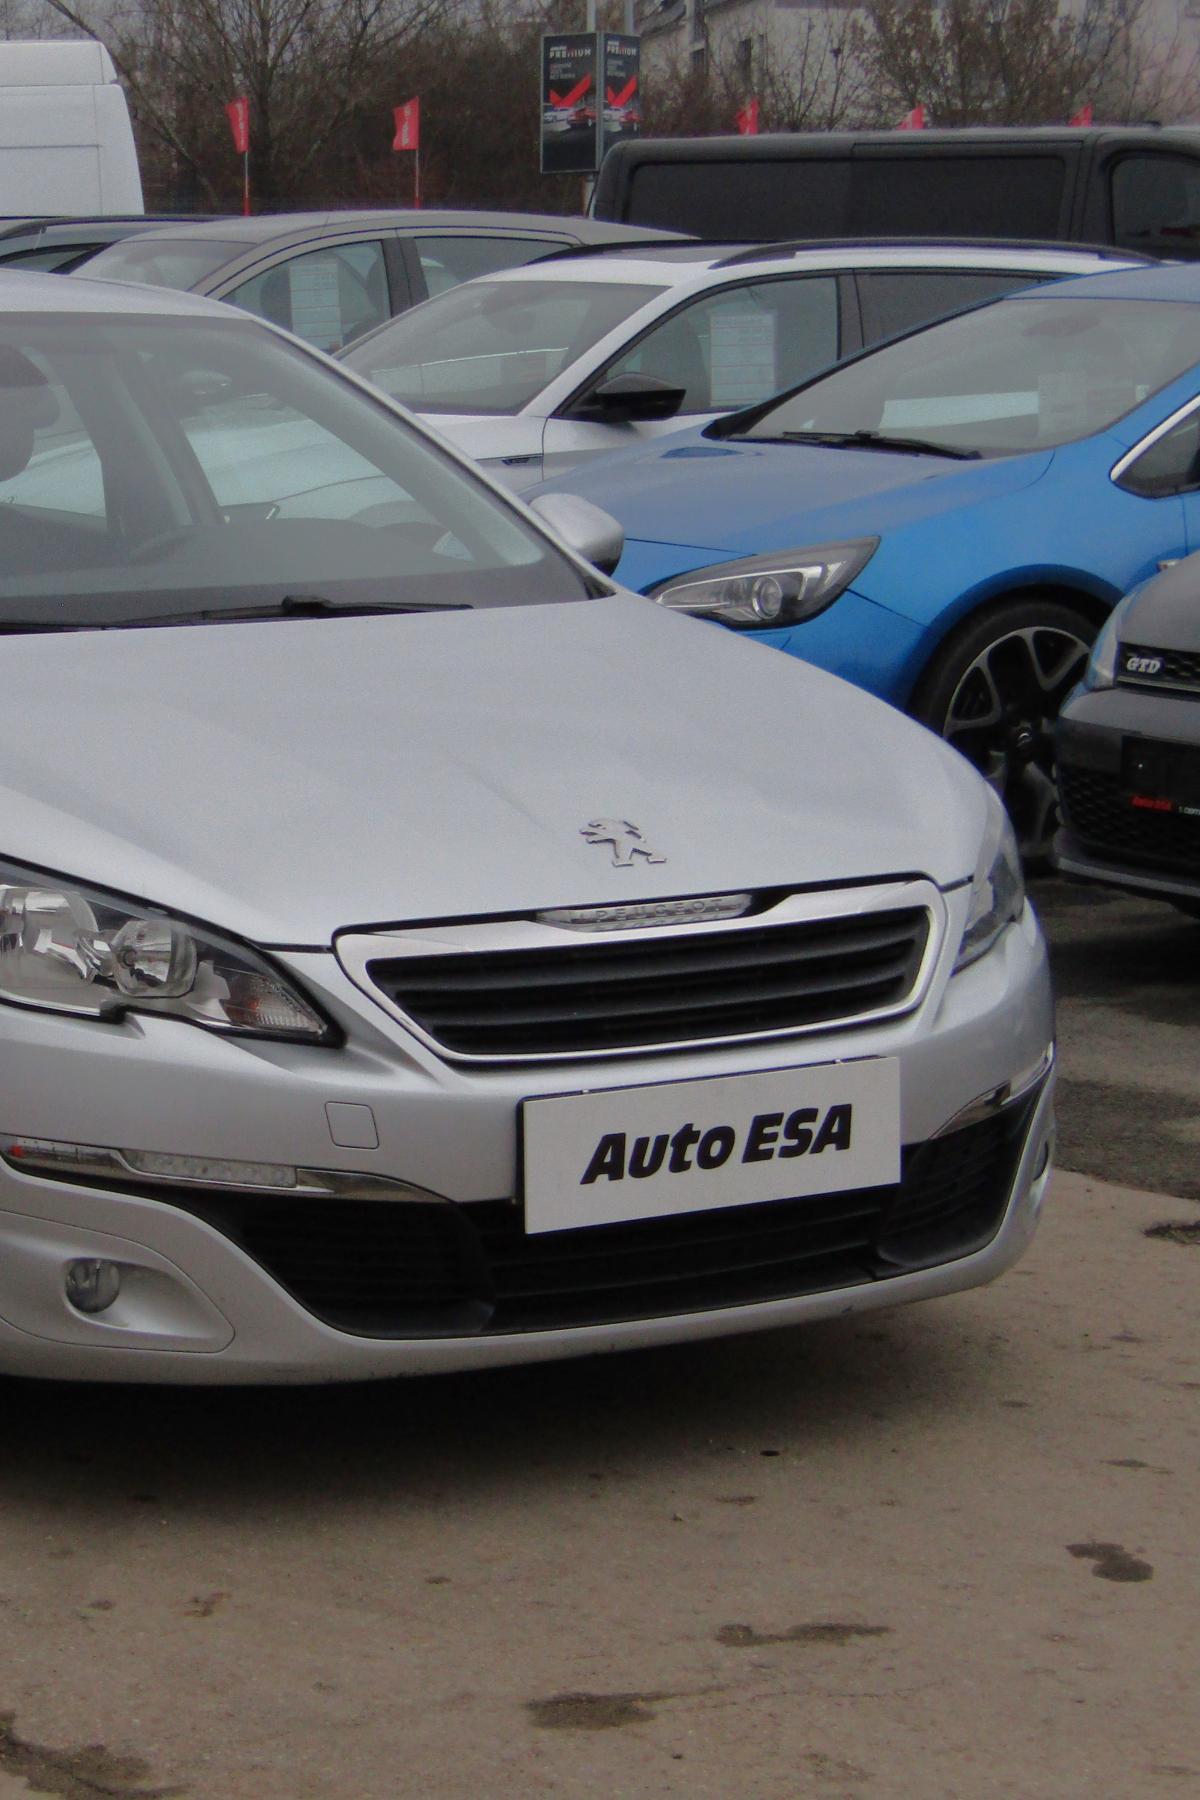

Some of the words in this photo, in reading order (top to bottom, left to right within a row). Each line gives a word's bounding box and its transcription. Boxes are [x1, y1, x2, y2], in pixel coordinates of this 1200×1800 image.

[1126, 657, 1161, 674] GTD
[579, 1122, 735, 1185] Auto
[741, 1103, 853, 1164] ESA
